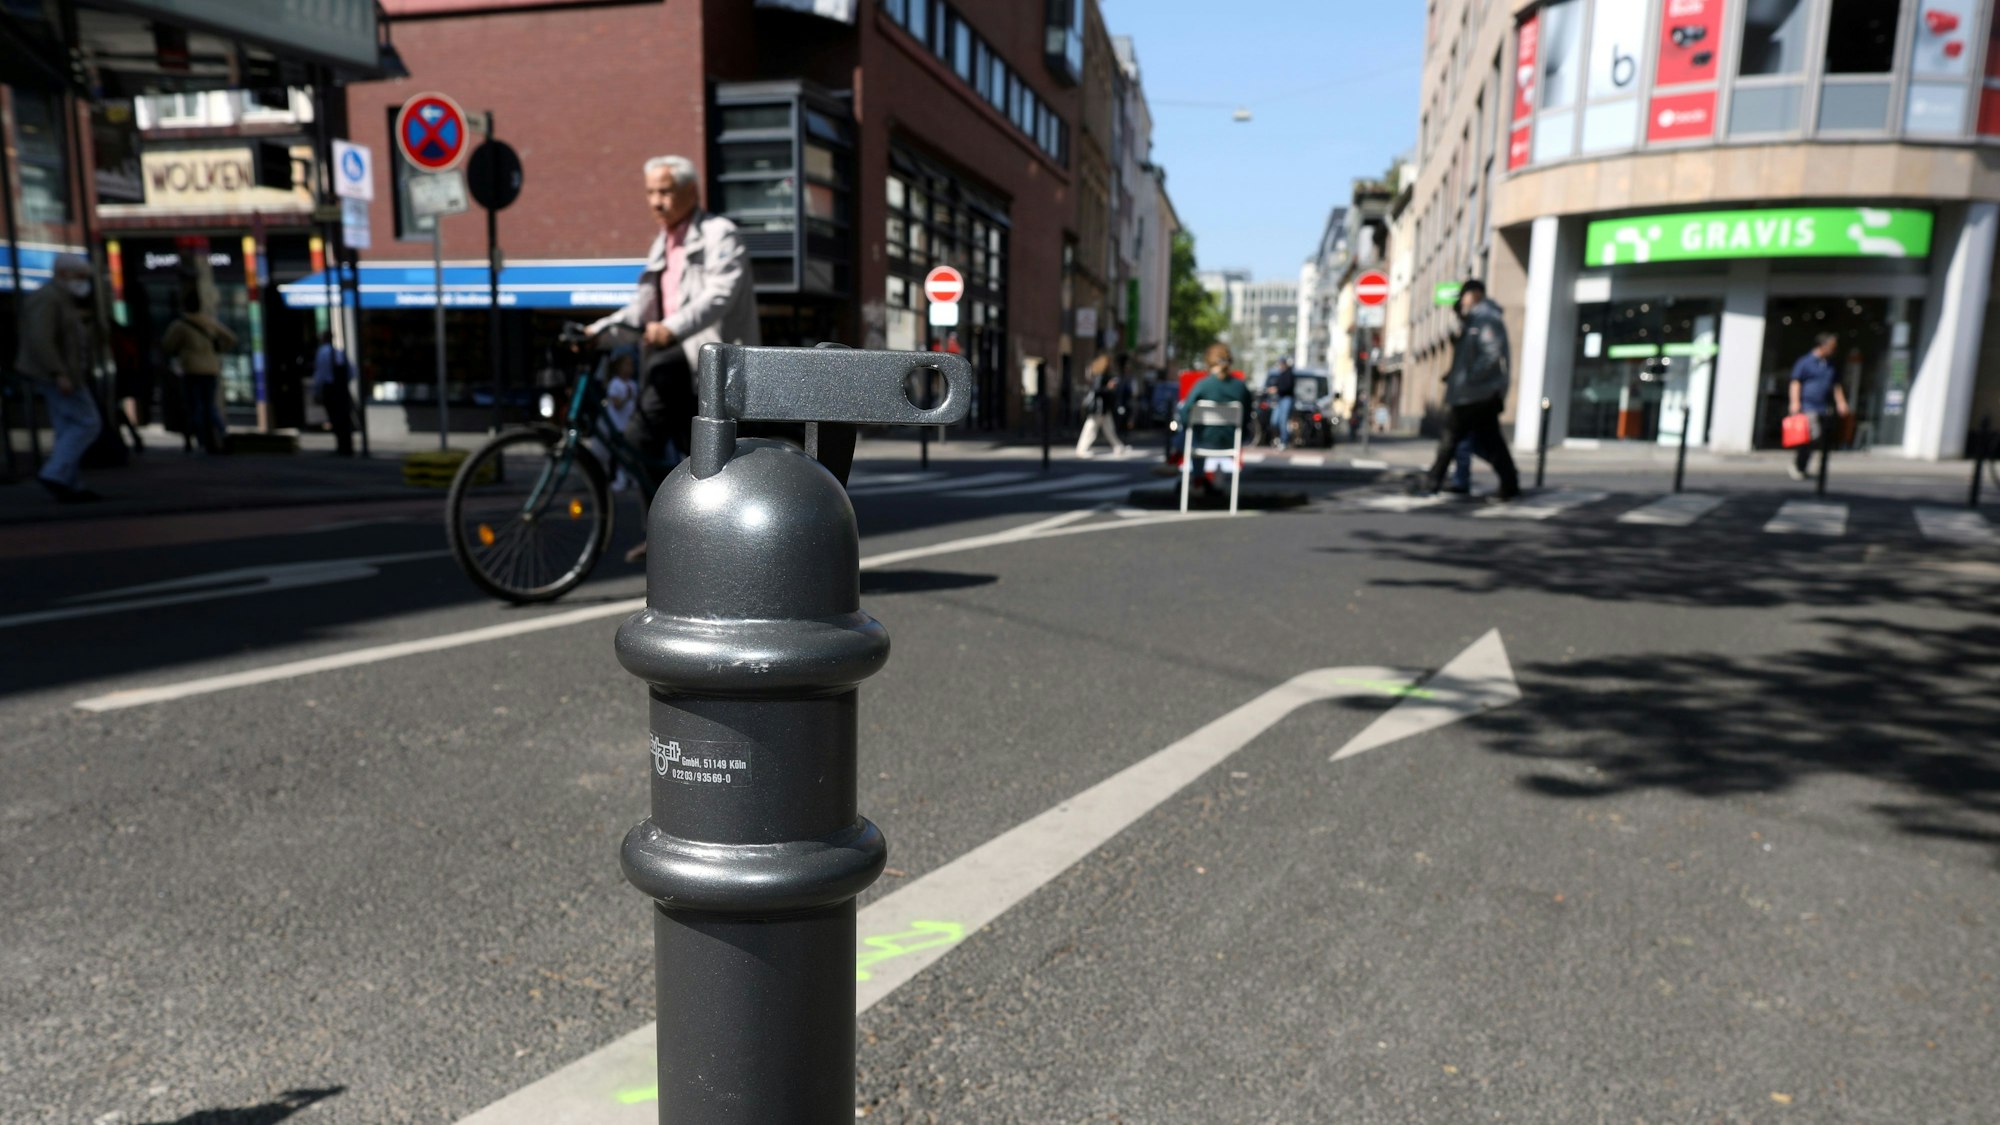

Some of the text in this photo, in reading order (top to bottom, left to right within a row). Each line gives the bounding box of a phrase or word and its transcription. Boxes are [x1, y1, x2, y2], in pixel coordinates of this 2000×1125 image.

[147, 160, 254, 193] WOLKEN
[1680, 216, 1816, 251] GRAVIS
[703, 758, 726, 769] 51149
[729, 759, 746, 769] Köln
